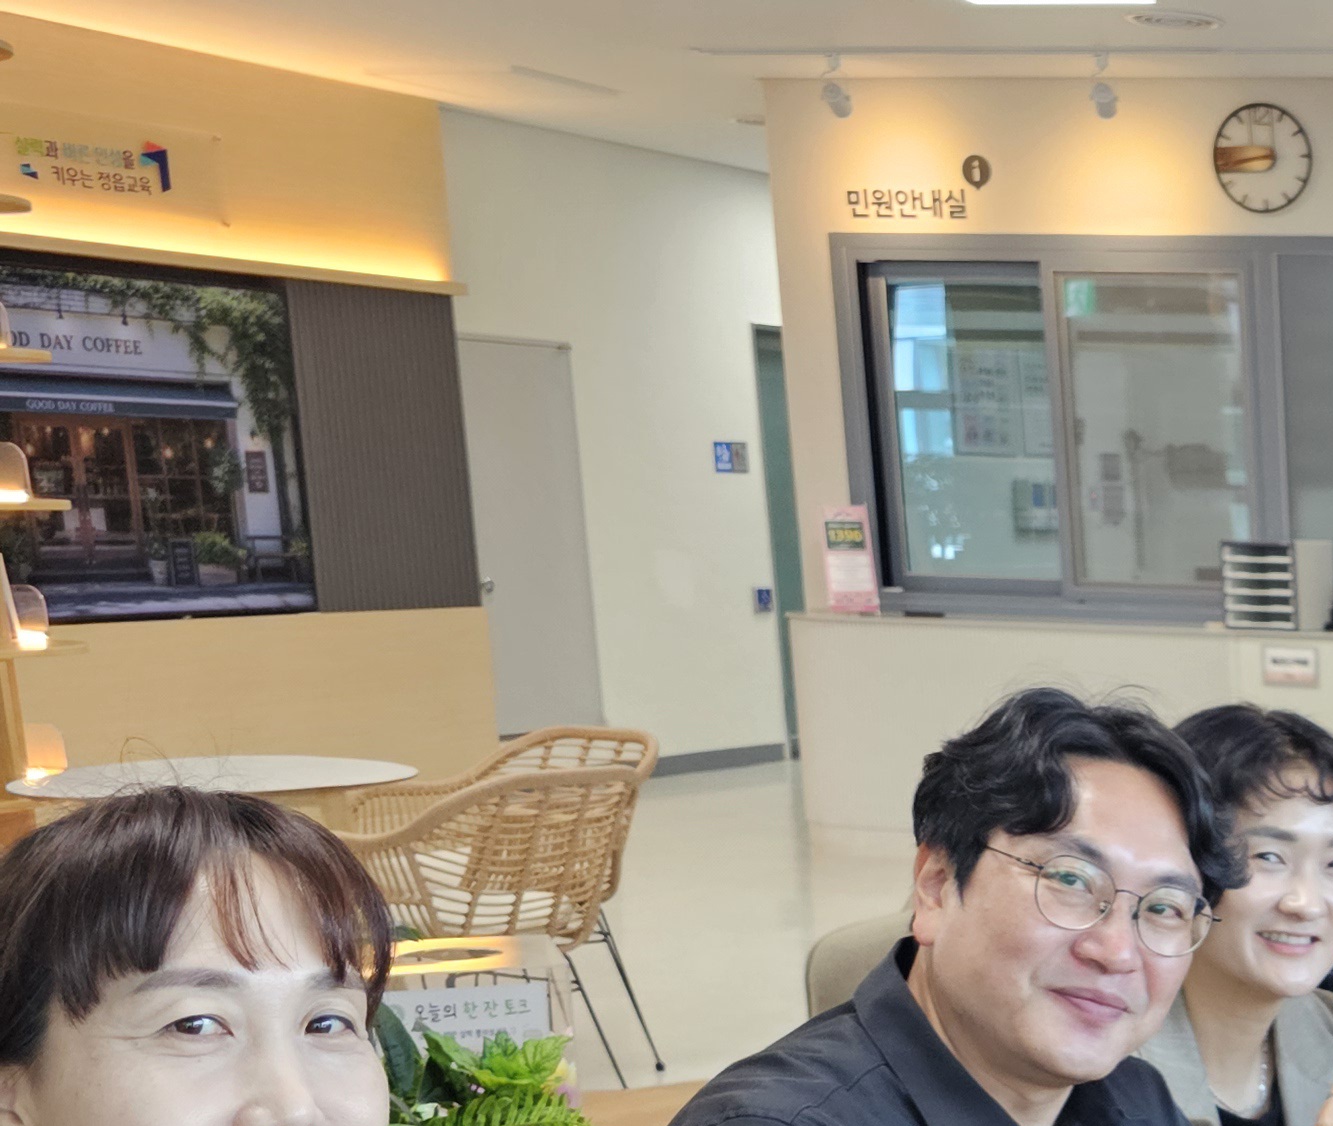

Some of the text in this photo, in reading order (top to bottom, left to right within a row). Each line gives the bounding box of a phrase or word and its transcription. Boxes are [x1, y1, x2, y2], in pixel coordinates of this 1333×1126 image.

[51, 166, 153, 195] 키우는 정읍교육
[846, 188, 968, 219] 민원안내실
[40, 332, 73, 351] DAY
[82, 336, 143, 356] COFFEE
[25, 399, 55, 411] GOOD
[57, 401, 77, 412] DAY
[415, 998, 531, 1022] 오늘의 한 잔 토크
